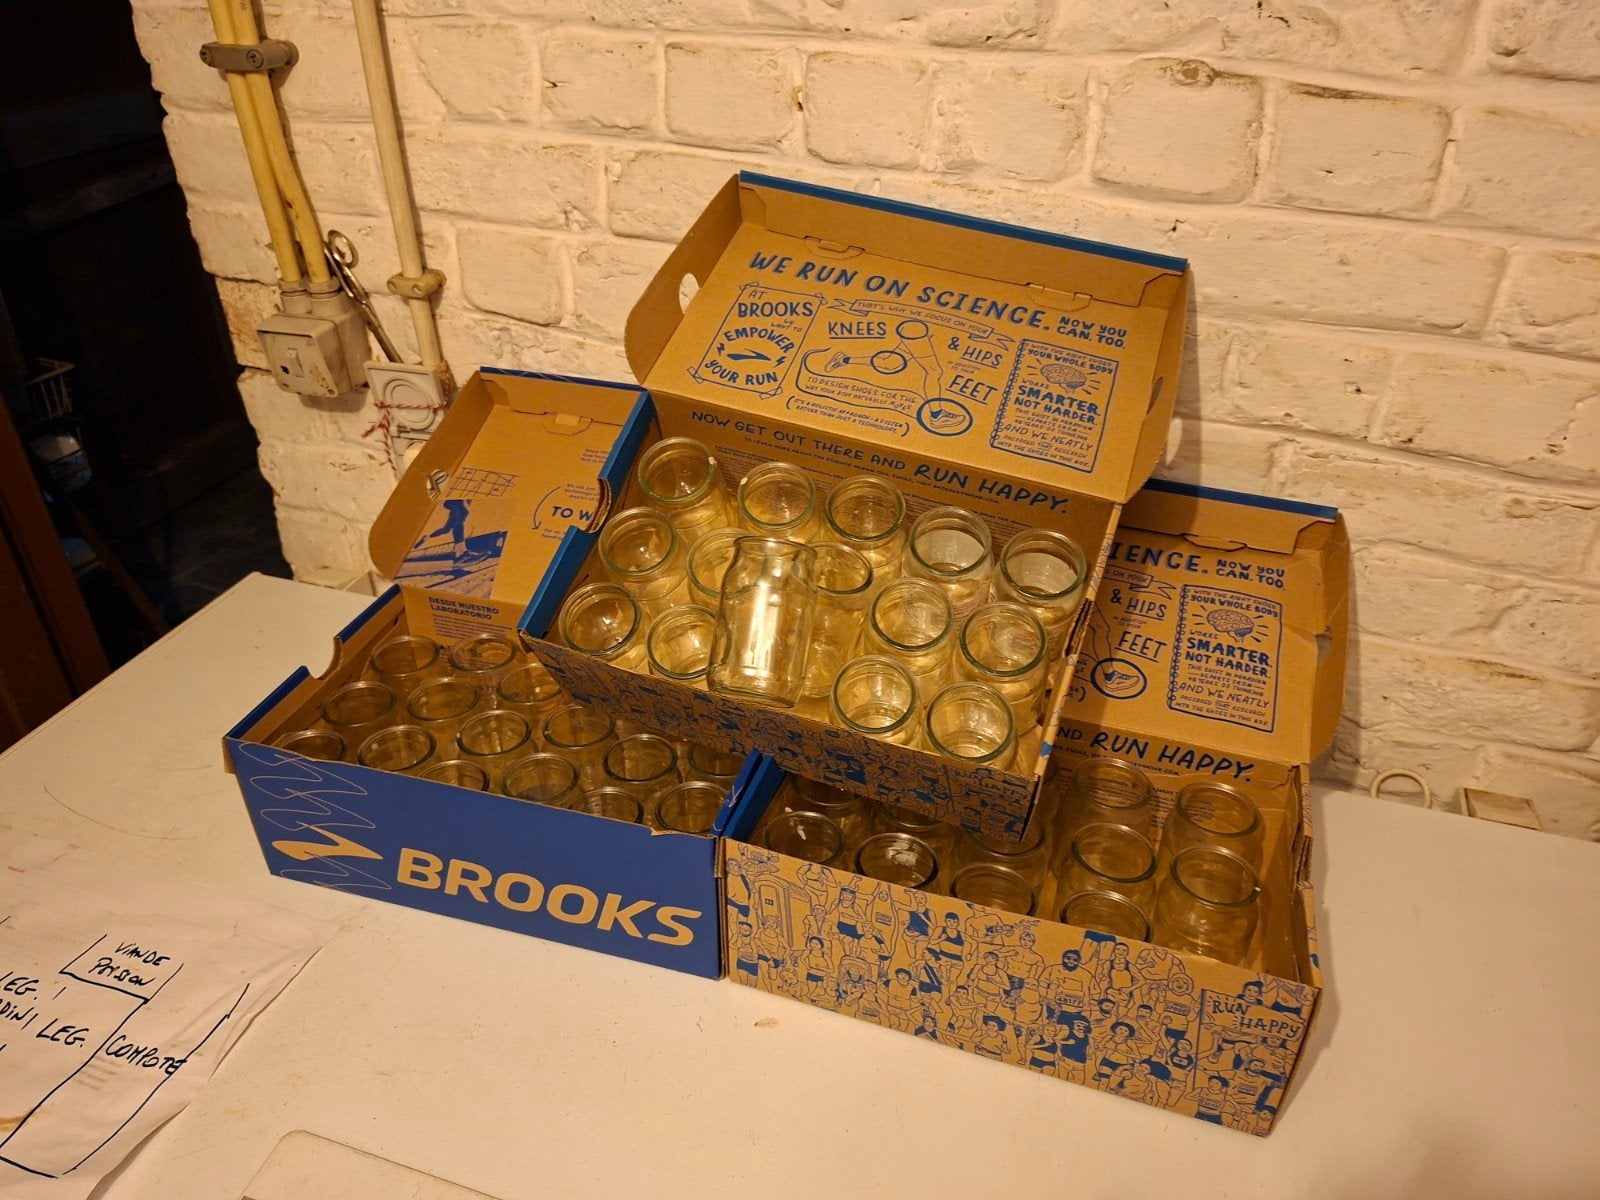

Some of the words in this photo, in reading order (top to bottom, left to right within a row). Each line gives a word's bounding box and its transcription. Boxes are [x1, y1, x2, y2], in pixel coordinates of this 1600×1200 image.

[748, 290, 767, 300] AT
[749, 252, 793, 274] WE
[796, 261, 858, 287] RUN
[864, 275, 910, 298] ON
[916, 286, 1050, 331] SCIENCE.
[738, 302, 814, 317] BROOKS
[857, 301, 885, 311] THAT'S
[888, 305, 906, 314] WHY
[910, 309, 922, 317] WE
[924, 312, 951, 323] FOCUS
[954, 318, 966, 326] ON
[968, 322, 989, 335] YOUR
[723, 327, 795, 353] EMPOWER
[828, 321, 887, 336] KNEES
[1059, 316, 1095, 330] NOW
[1099, 325, 1127, 338] YOU
[948, 336, 960, 351] &
[963, 345, 1003, 366] HIPS
[1097, 334, 1127, 349] TOO.
[704, 359, 739, 383] YOUR
[745, 372, 778, 385] RUN
[1028, 348, 1052, 359] YOUR
[1054, 354, 1087, 368] WHOLE
[1089, 363, 1114, 375] BODY
[819, 378, 849, 390] DESIGN
[851, 384, 879, 396] SHOES
[881, 391, 898, 400] FOR
[899, 394, 916, 403] THE
[949, 374, 998, 400] FEET
[1014, 396, 1041, 410] NOT
[1044, 404, 1098, 425] HARDER.
[1004, 423, 1028, 435] AND
[1031, 430, 1048, 440] WE
[1050, 435, 1093, 451] NEATLY
[691, 410, 730, 427] NOW
[734, 421, 767, 436] GET
[773, 430, 806, 446] OUT
[813, 439, 864, 460] THERE
[871, 454, 906, 470] AND
[914, 463, 969, 488] RUN
[978, 478, 1069, 514] HAPPY.
[552, 506, 573, 519] TO
[1217, 559, 1252, 571] NOW
[1257, 565, 1285, 578] YOU
[1256, 574, 1286, 591] TOO.
[429, 597, 456, 606] DESDE
[459, 601, 499, 614] NUESTRO
[431, 604, 492, 620] LABORATORIO
[1110, 588, 1122, 605] &
[1126, 597, 1167, 618] HIPS
[1191, 594, 1216, 605] YOUR
[1218, 598, 1252, 611] WHOLE
[1255, 605, 1279, 618] BODY
[1118, 631, 1167, 658] FEET
[1185, 651, 1212, 664] NOT
[1179, 682, 1204, 694] AND
[1207, 688, 1225, 698] WE
[1226, 693, 1270, 708] NEATLY
[1090, 731, 1150, 759] RUN
[1158, 745, 1255, 782] HAPPY.
[396, 846, 703, 947] BROOKS
[1212, 1000, 1250, 1015] RUN
[36, 1018, 89, 1048] LEG.
[1240, 1016, 1301, 1038] HAPPY
